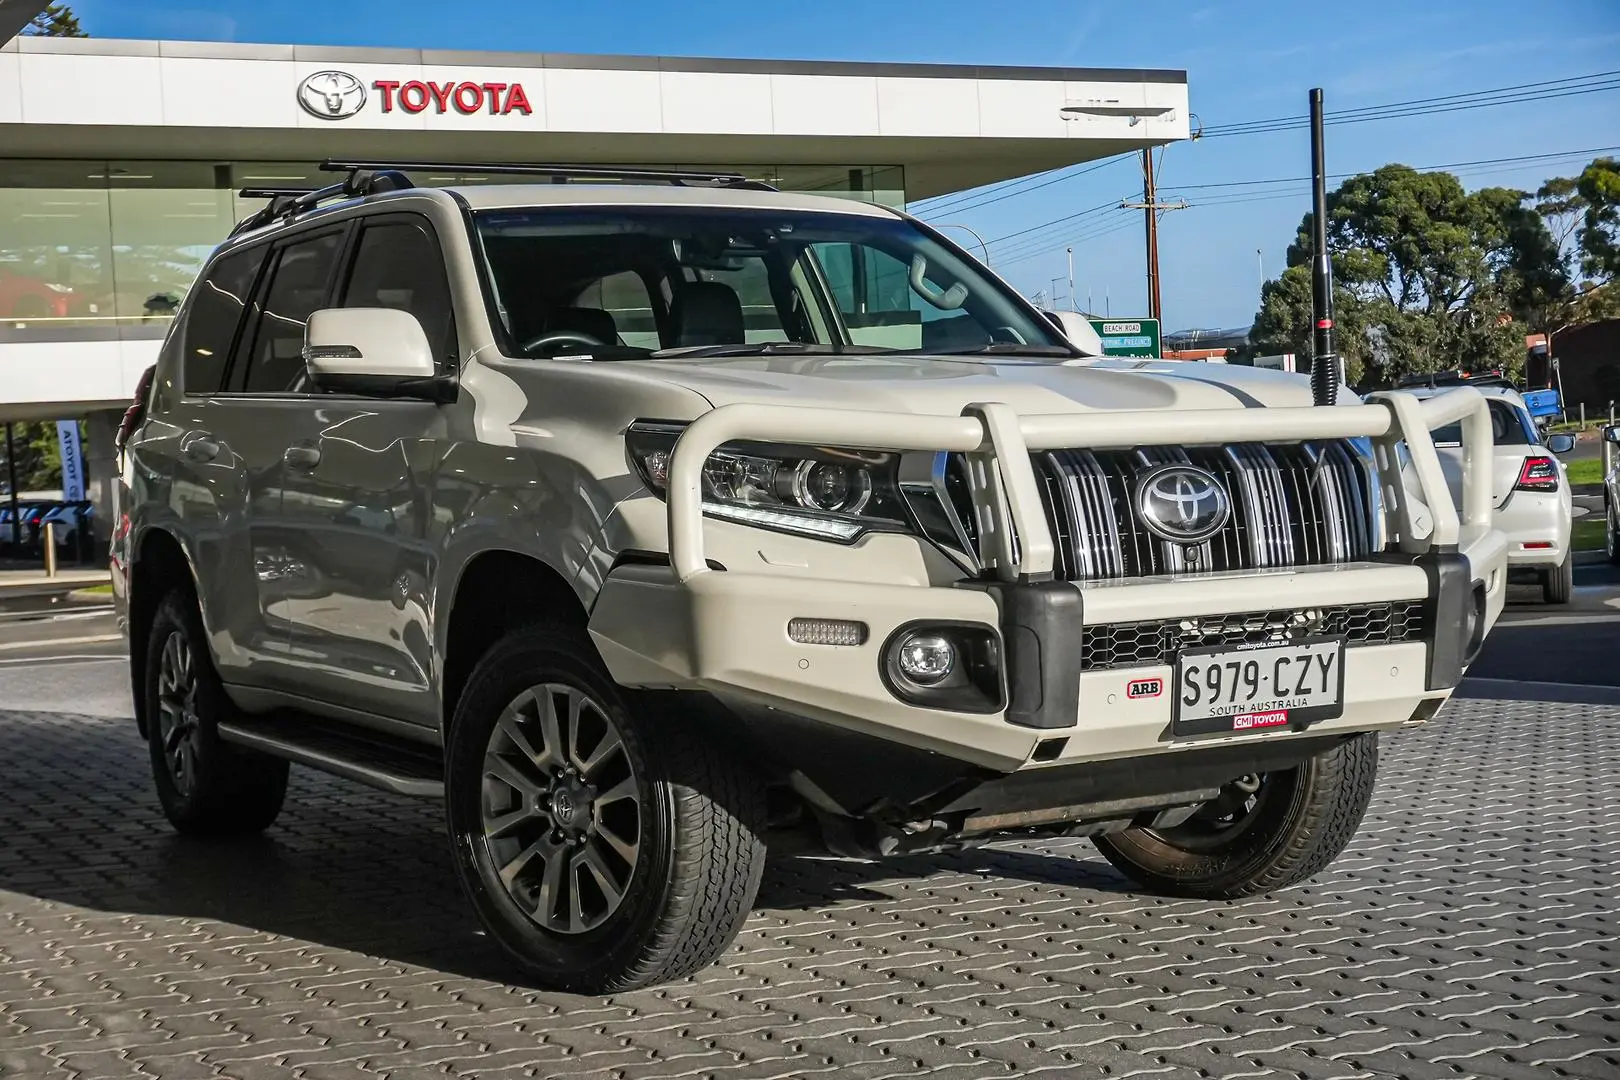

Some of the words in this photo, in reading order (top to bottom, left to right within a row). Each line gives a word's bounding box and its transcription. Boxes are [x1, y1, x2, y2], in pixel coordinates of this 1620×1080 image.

[373, 80, 533, 114] TOYOTA
[1124, 324, 1140, 332] ROAD
[1236, 640, 1290, 650] cmitoyota.com.au
[1131, 682, 1159, 695] ARB
[1210, 704, 1245, 716] SOUTH
[1250, 698, 1308, 712] AUSTRALIA
[1235, 716, 1252, 727] CMI
[1253, 713, 1286, 725] TOYOTA
